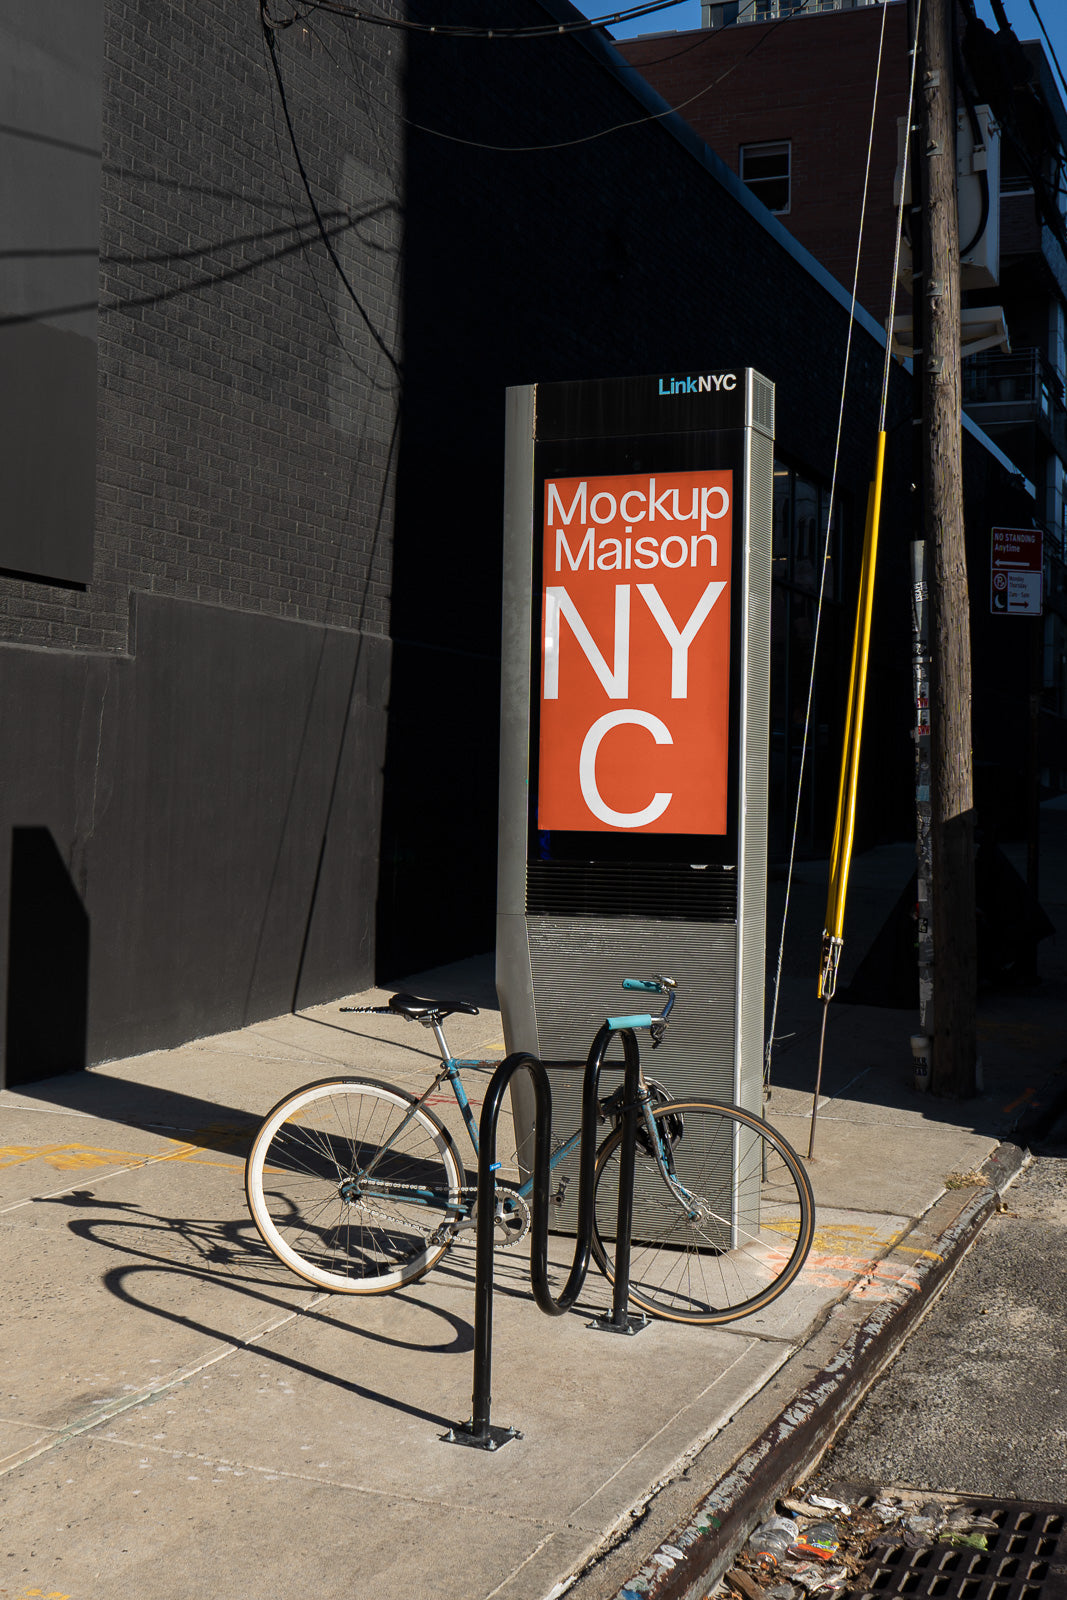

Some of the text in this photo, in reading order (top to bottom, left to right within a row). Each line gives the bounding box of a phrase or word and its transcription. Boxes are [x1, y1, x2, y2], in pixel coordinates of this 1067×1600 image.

[658, 373, 737, 396] LinkNYC
[547, 477, 731, 533] Mockup
[555, 525, 719, 573] Maison
[994, 532, 1036, 544] NO STANDING
[994, 543, 1021, 553] Anytime
[542, 580, 729, 701] NY
[579, 708, 674, 829] C
